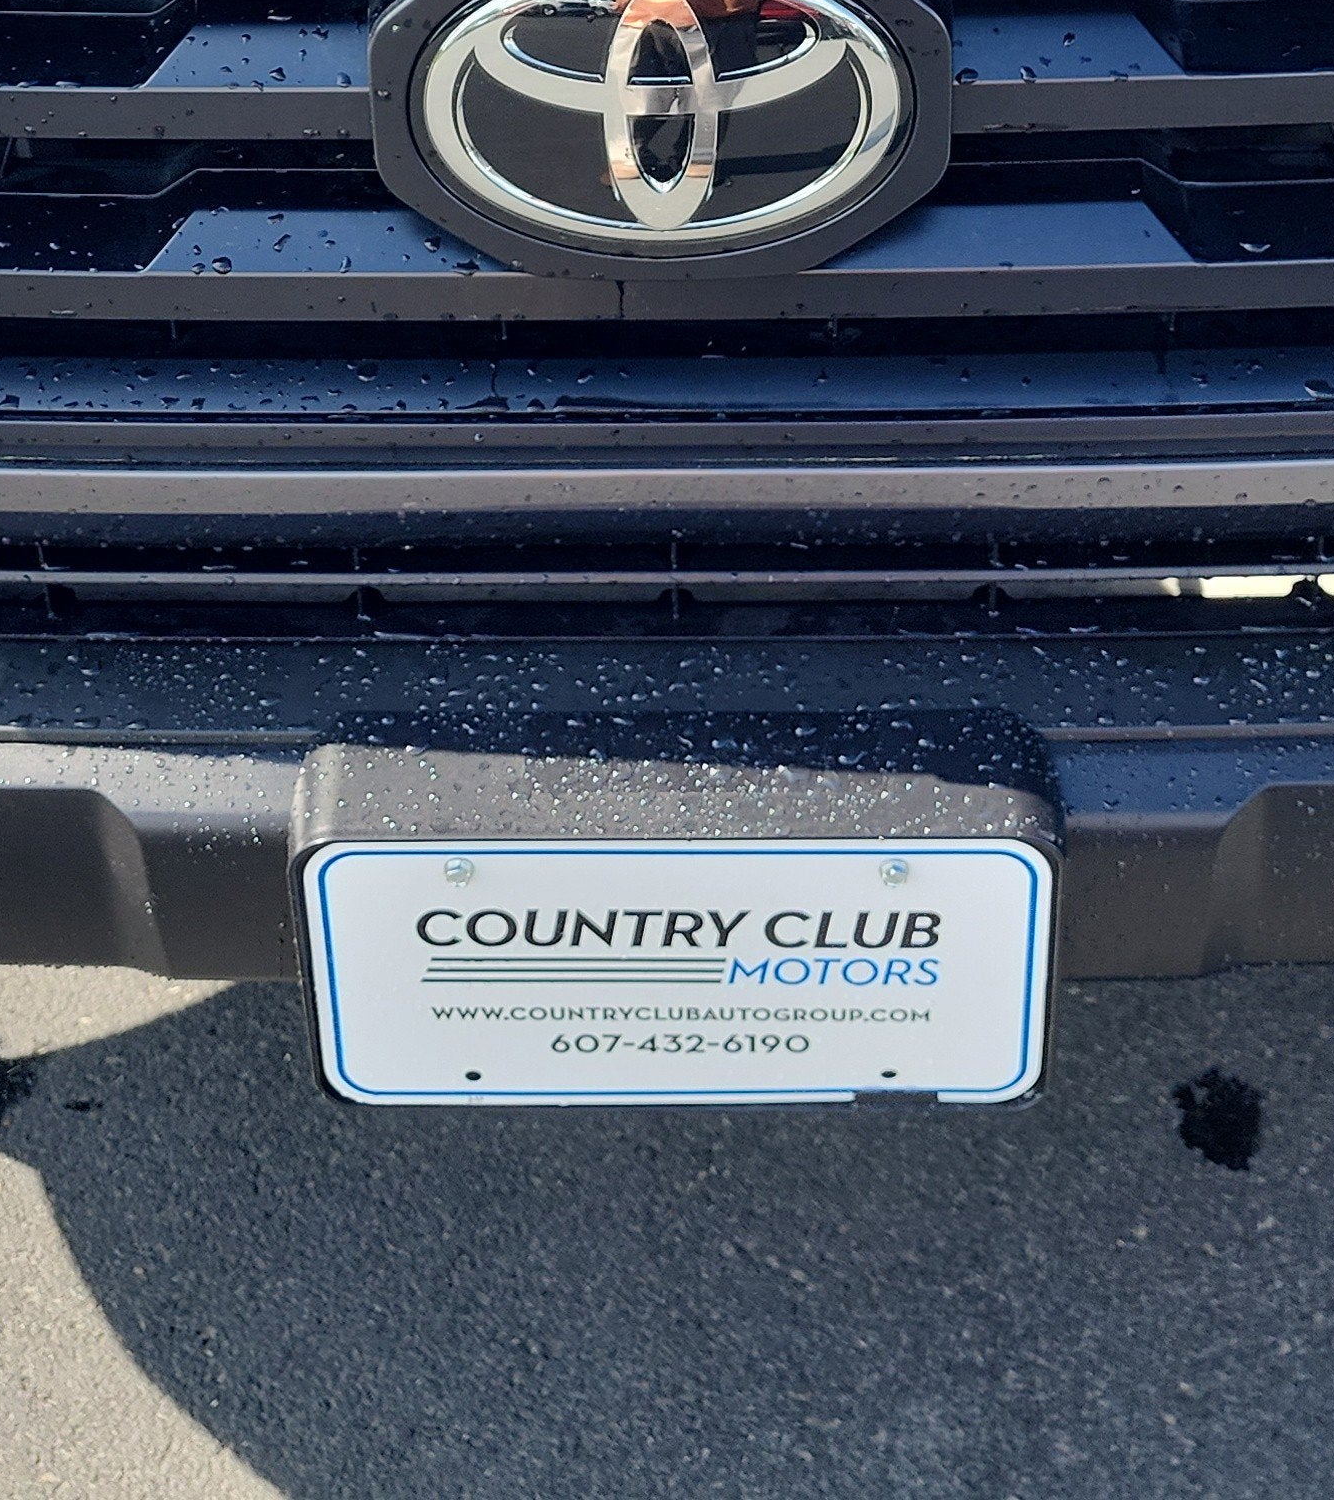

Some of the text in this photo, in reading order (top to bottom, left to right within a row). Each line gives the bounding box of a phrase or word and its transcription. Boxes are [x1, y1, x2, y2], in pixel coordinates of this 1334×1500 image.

[416, 909, 940, 948] COUNTRY CLUB
[728, 958, 939, 986] MOTORS
[432, 1007, 929, 1021] WWW.COUNTRYCLUBAUTOGROUP.COM
[551, 1035, 809, 1053] 607-432-6190
